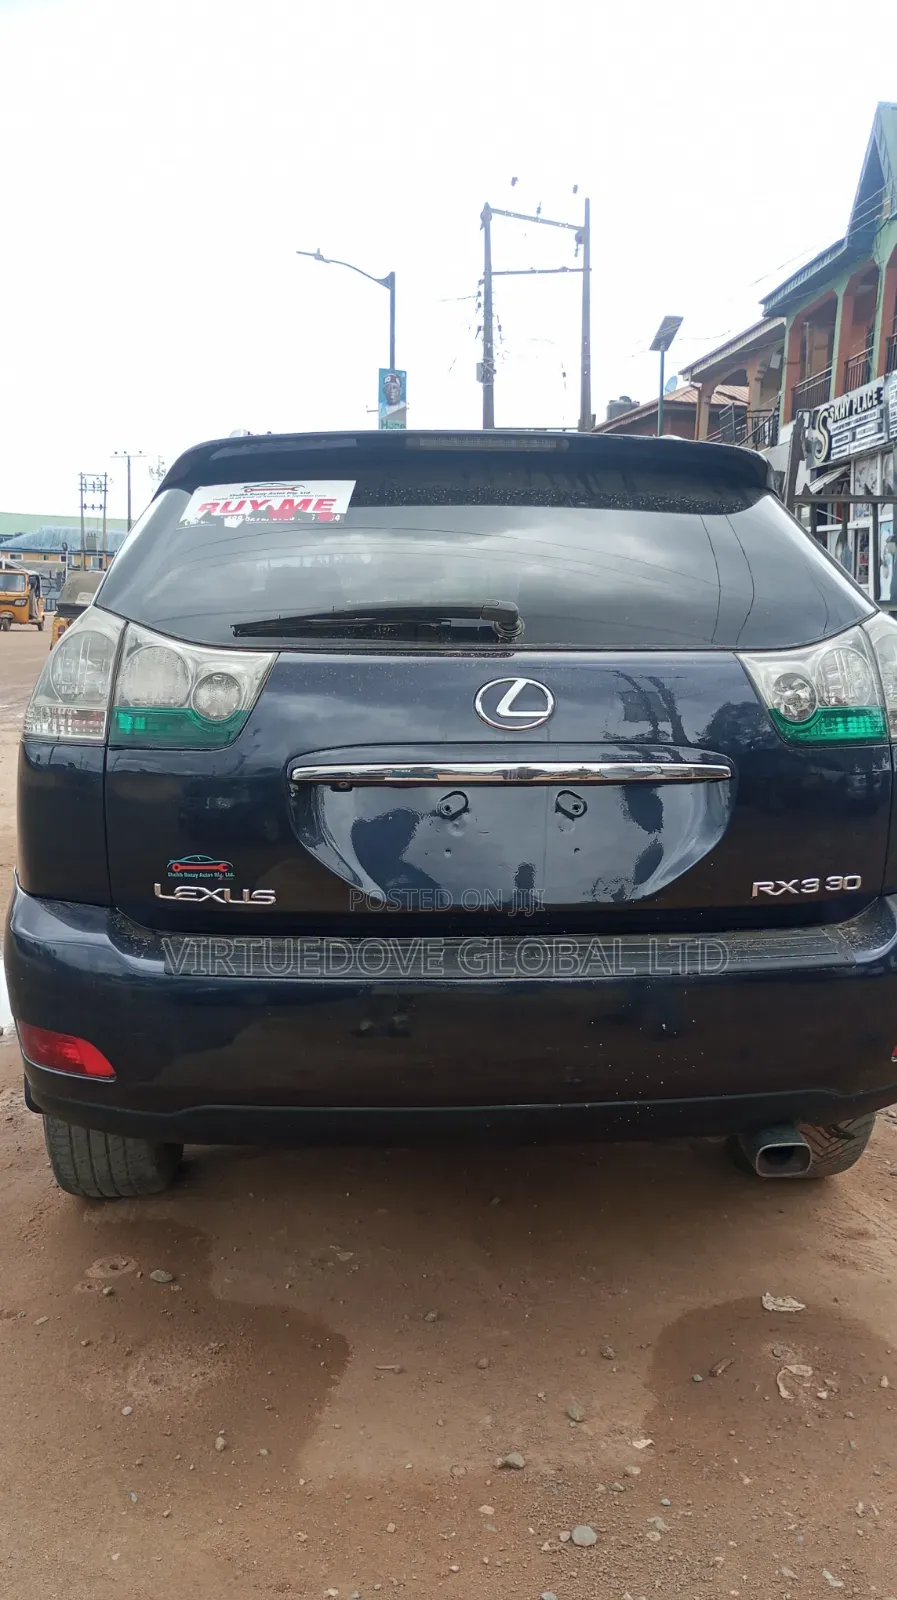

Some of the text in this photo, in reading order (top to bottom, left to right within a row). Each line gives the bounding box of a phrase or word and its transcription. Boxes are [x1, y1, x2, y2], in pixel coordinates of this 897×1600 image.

[853, 388, 882, 415] PLACE
[197, 498, 337, 514] BUY ME
[154, 883, 276, 905] LEXUS
